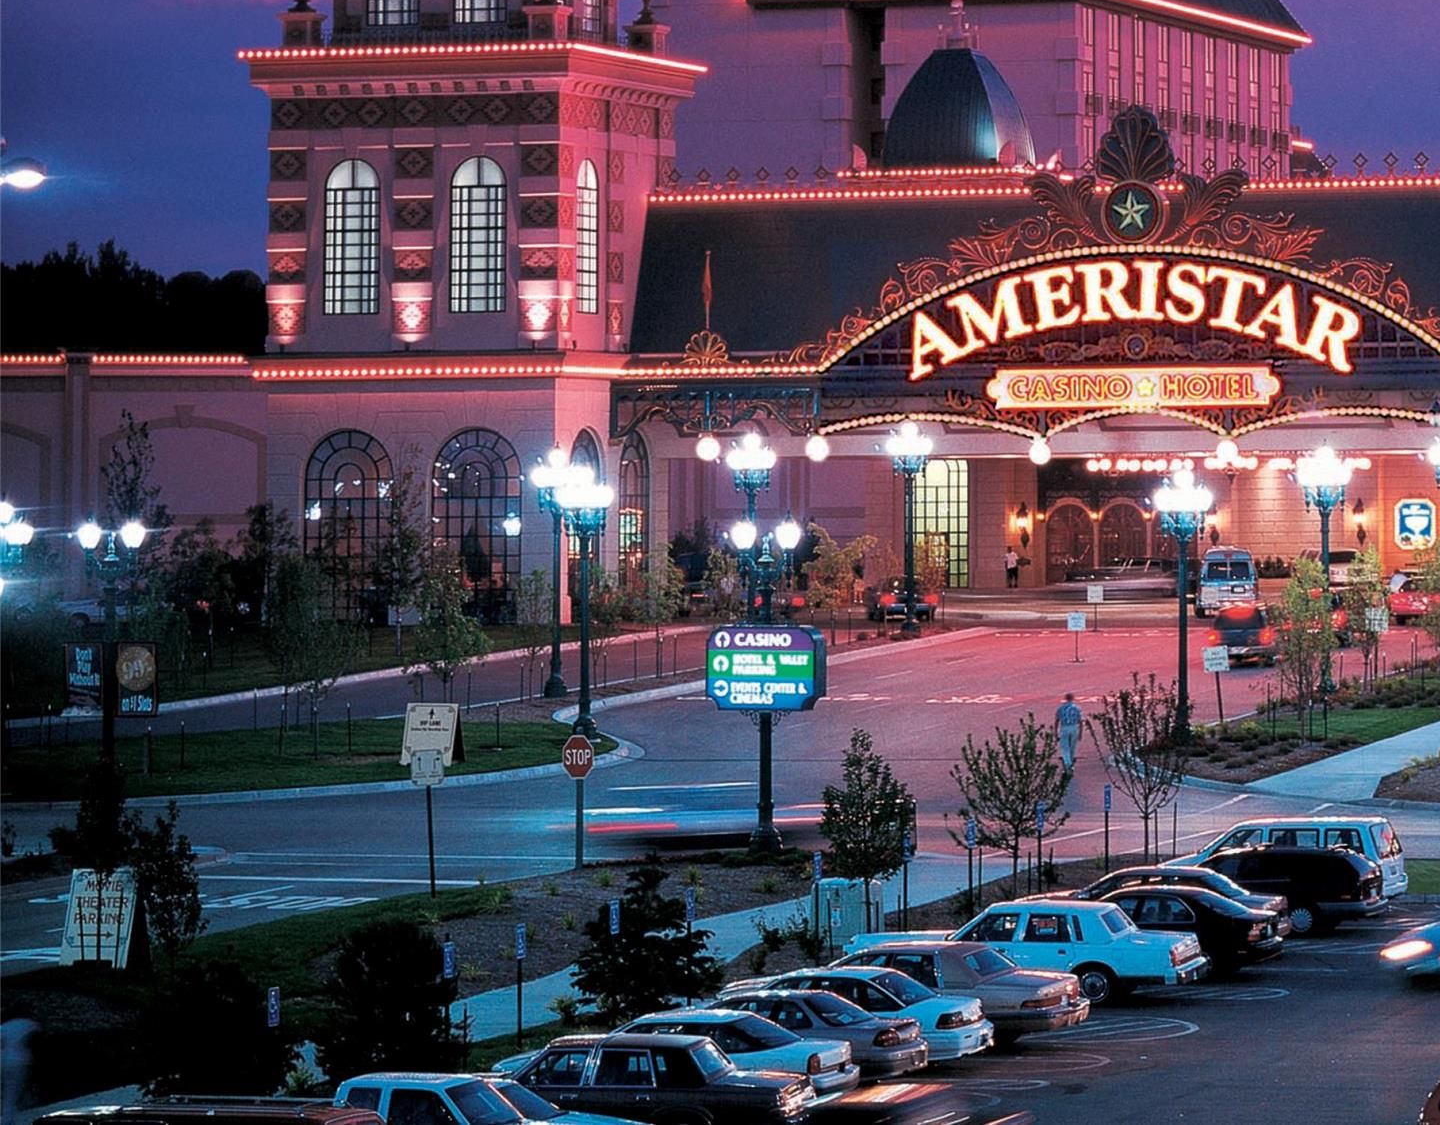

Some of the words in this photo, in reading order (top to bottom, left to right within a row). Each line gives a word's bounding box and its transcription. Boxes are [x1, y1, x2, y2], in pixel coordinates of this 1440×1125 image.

[909, 258, 1362, 381] AMERISTAR
[1007, 374, 1133, 401] CASINO
[1162, 374, 1259, 399] HOTEL
[734, 633, 792, 647] CASINO
[565, 749, 591, 765] STOP
[85, 880, 123, 892] MOVIE
[75, 896, 129, 909] THEATER
[74, 913, 125, 925] PARKING
